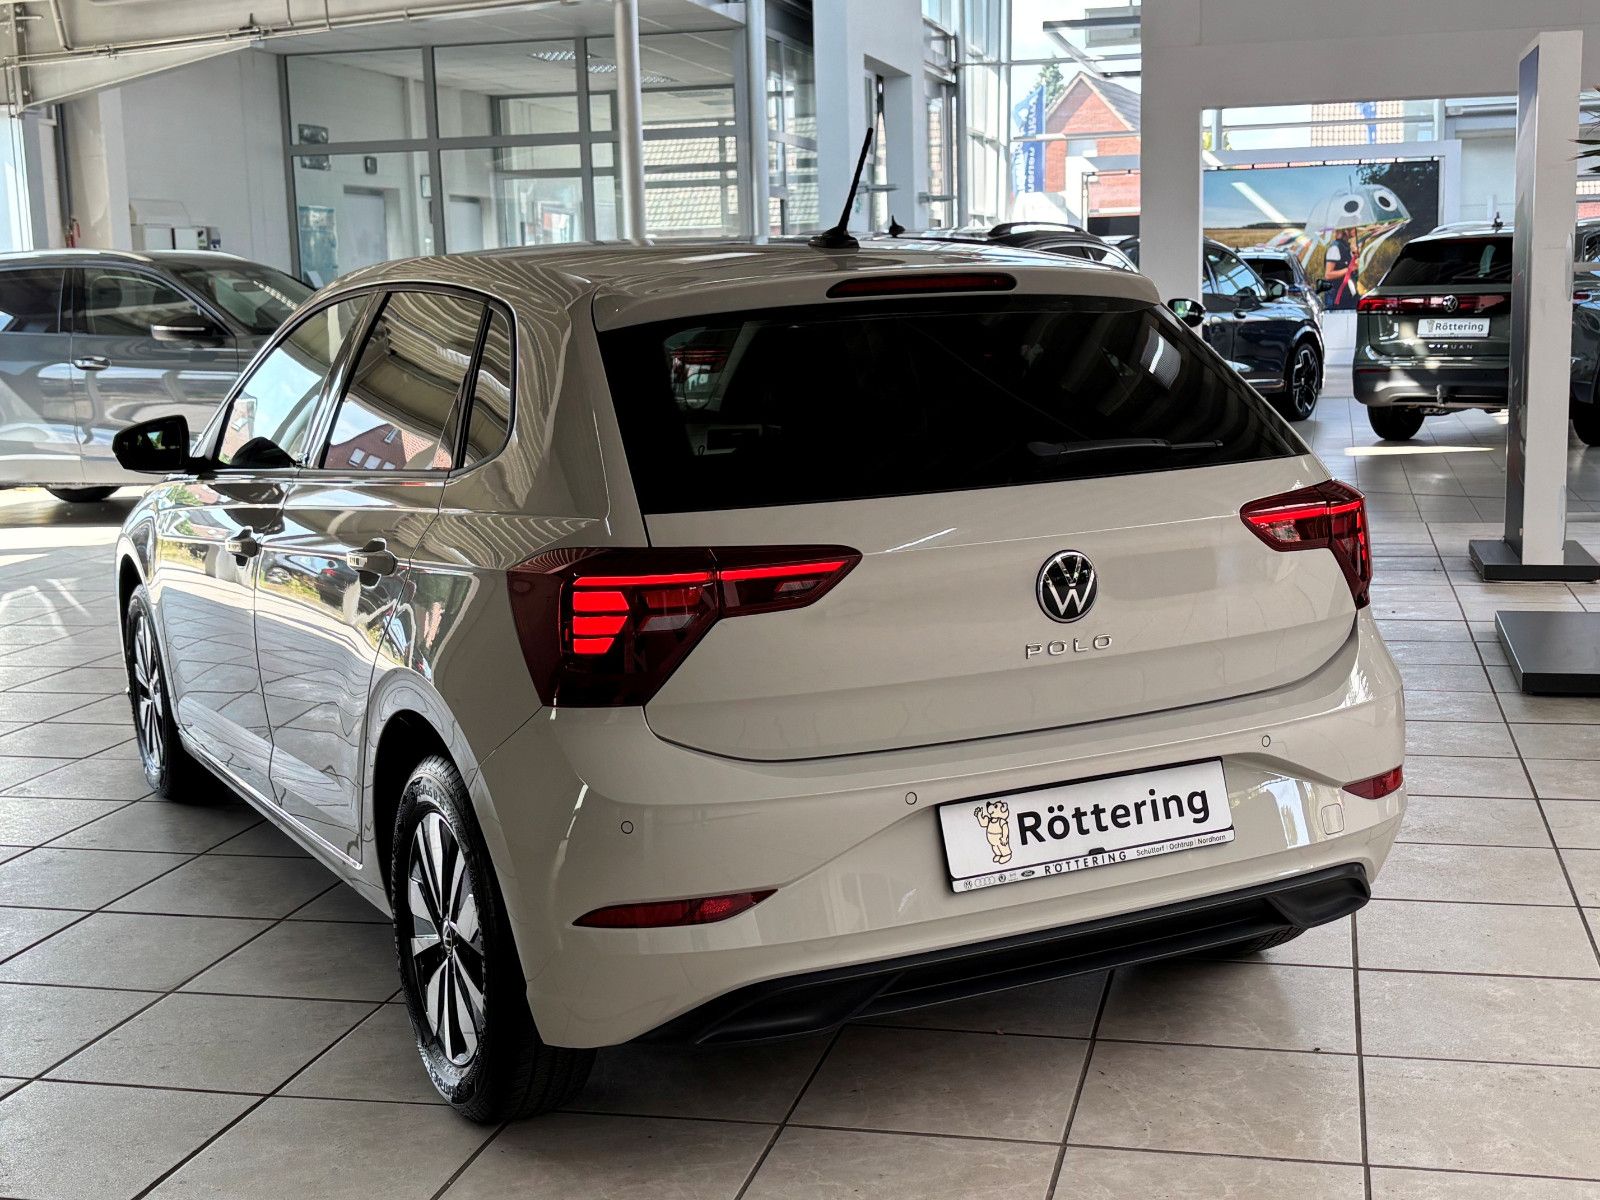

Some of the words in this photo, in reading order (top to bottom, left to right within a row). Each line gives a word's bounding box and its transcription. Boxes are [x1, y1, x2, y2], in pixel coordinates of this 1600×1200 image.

[1435, 322, 1484, 332] Röttering
[1025, 634, 1112, 659] POLO
[1018, 789, 1209, 845] Röttering
[1045, 852, 1126, 875] RÖTTERING
[1169, 841, 1194, 851] Ochtrup
[1198, 834, 1226, 844] Nordhorn
